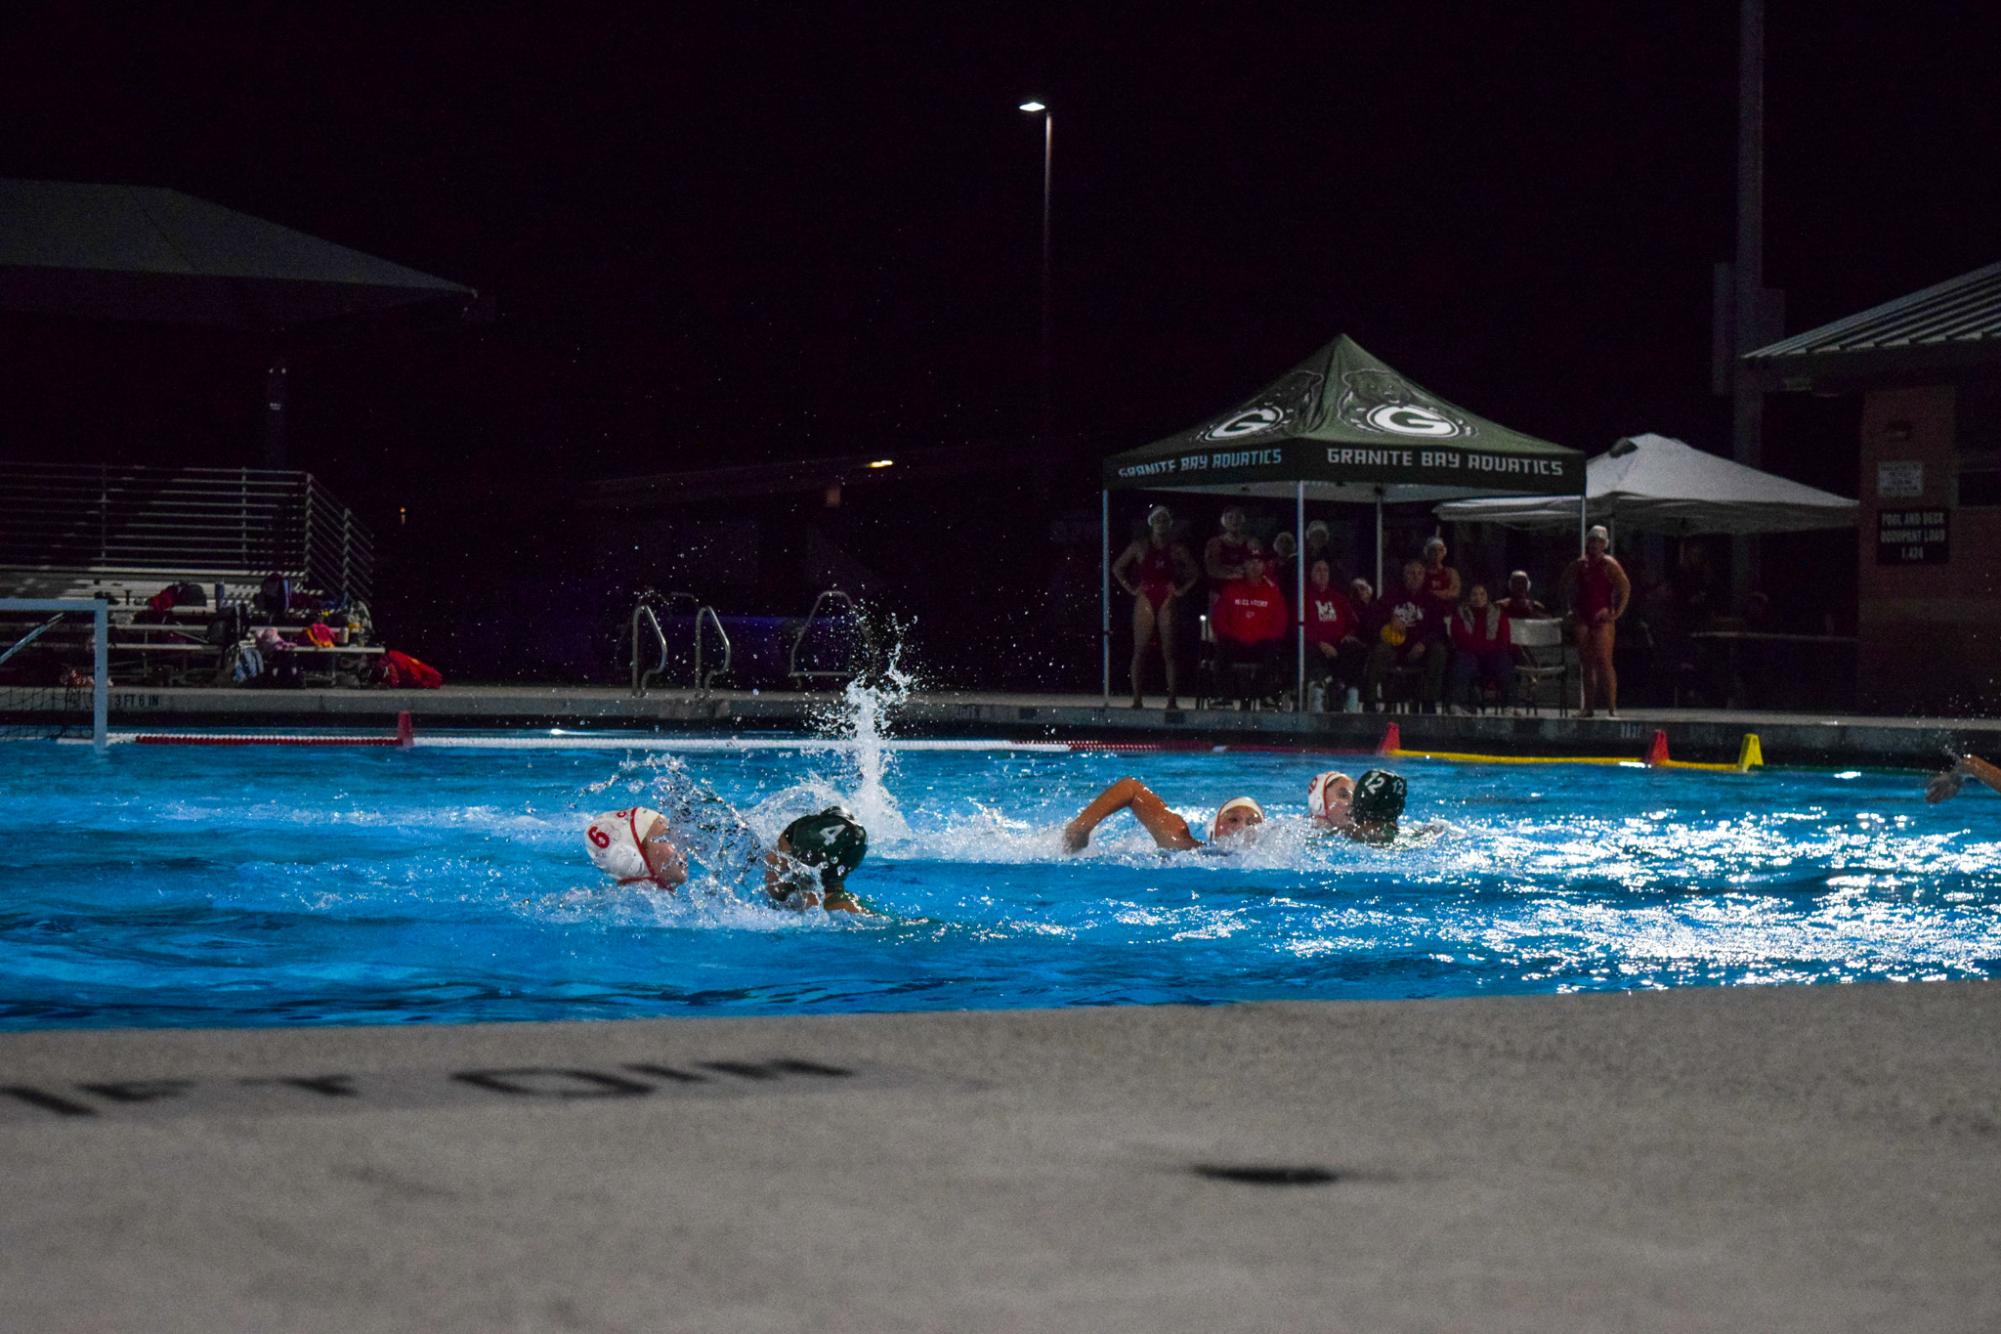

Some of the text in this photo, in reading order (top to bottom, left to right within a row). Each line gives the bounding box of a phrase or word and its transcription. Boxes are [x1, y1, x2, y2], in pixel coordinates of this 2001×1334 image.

[1208, 408, 1279, 438] G
[1371, 405, 1454, 436] G
[1211, 449, 1282, 468] AQUATICS
[1327, 448, 1564, 476] GRANITE BAY AQUATICS
[1365, 772, 1385, 795] 12
[1393, 779, 1404, 795] 12
[588, 825, 610, 849] 6
[817, 823, 847, 846] 4
